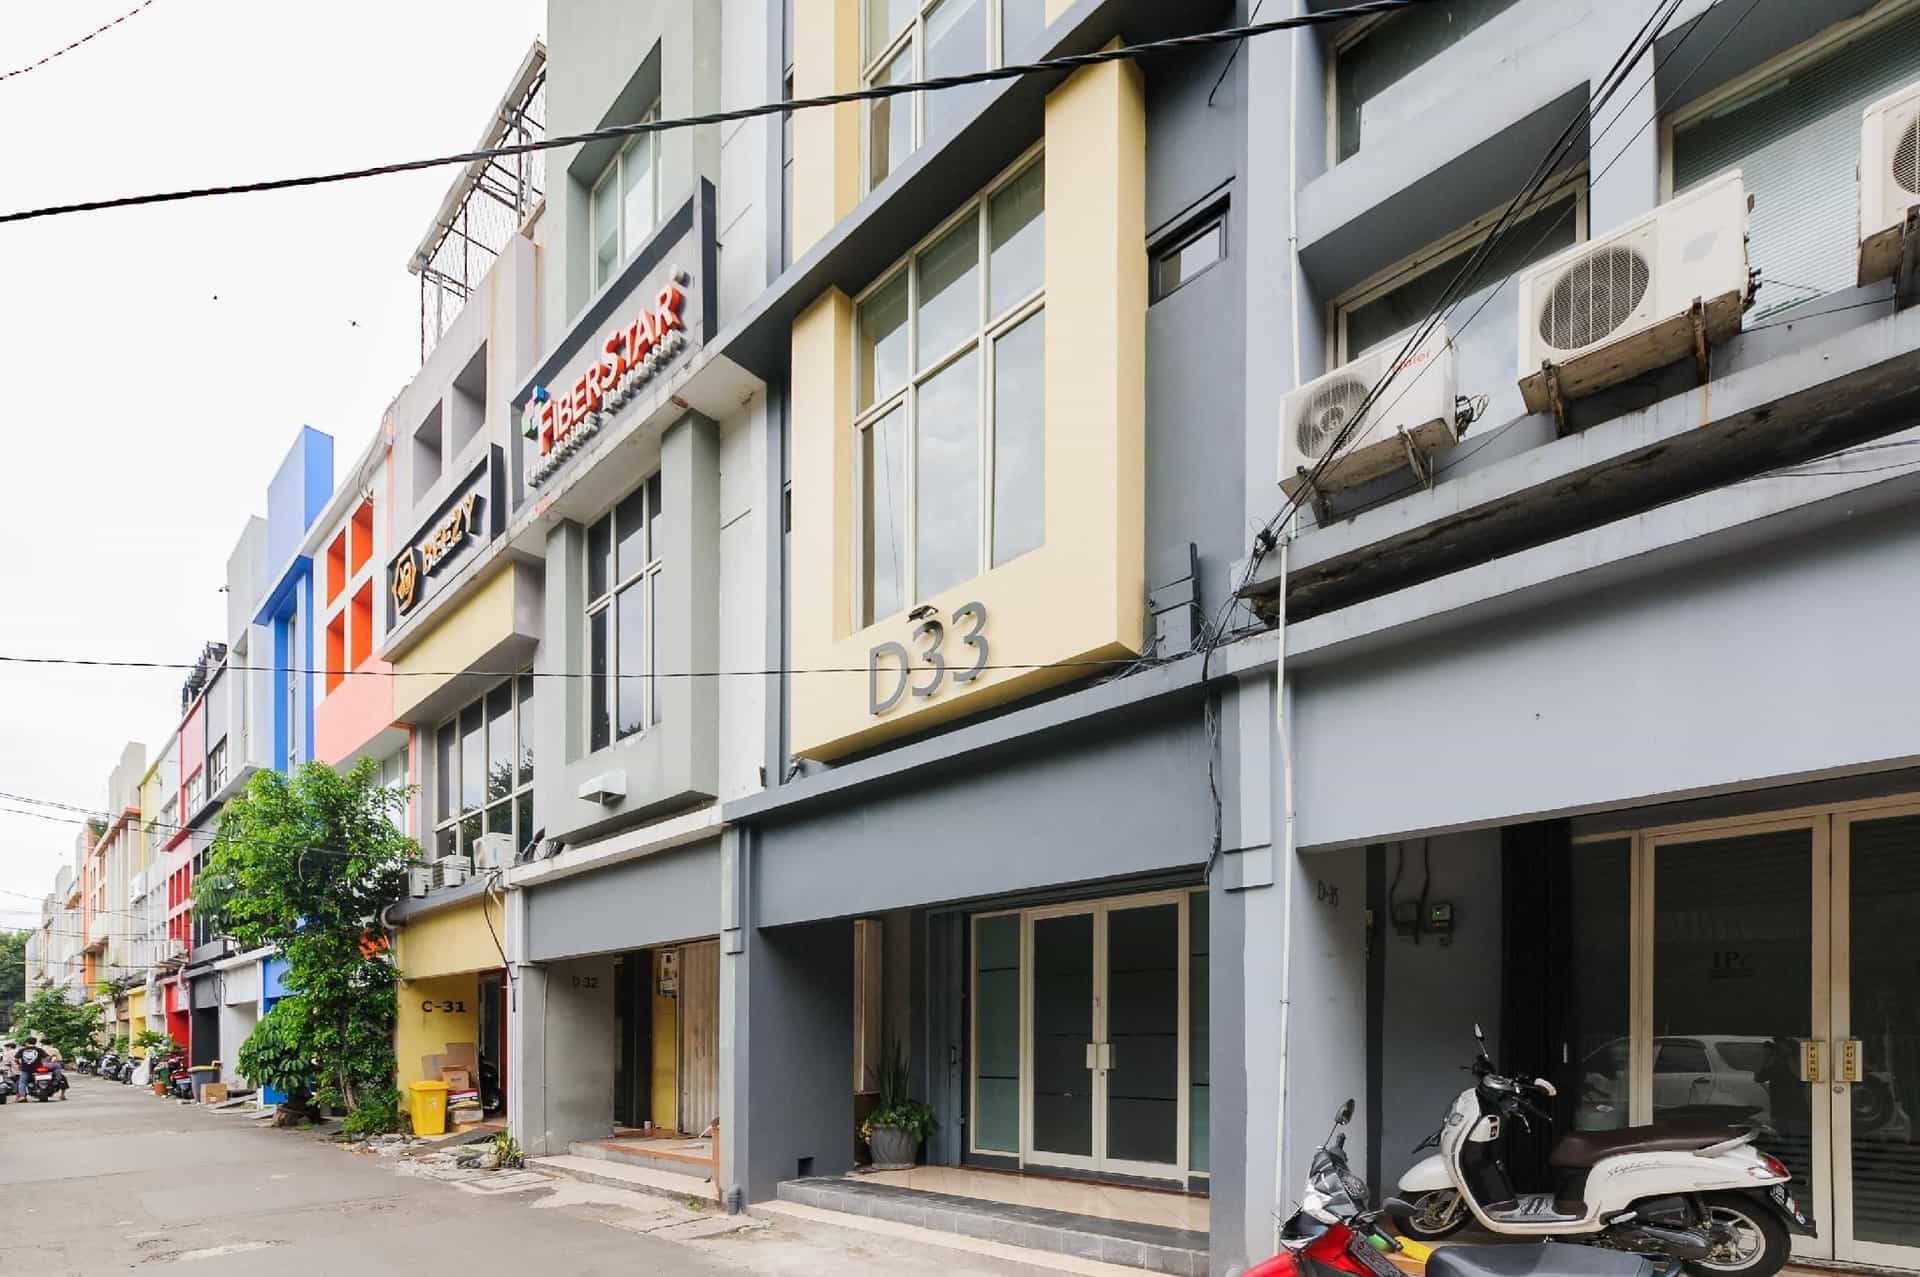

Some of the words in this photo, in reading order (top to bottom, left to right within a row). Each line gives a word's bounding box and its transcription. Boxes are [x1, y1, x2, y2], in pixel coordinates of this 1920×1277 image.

[537, 284, 682, 456] FIBERSTAR
[869, 601, 989, 715] D33
[421, 1000, 467, 1014] C-31
